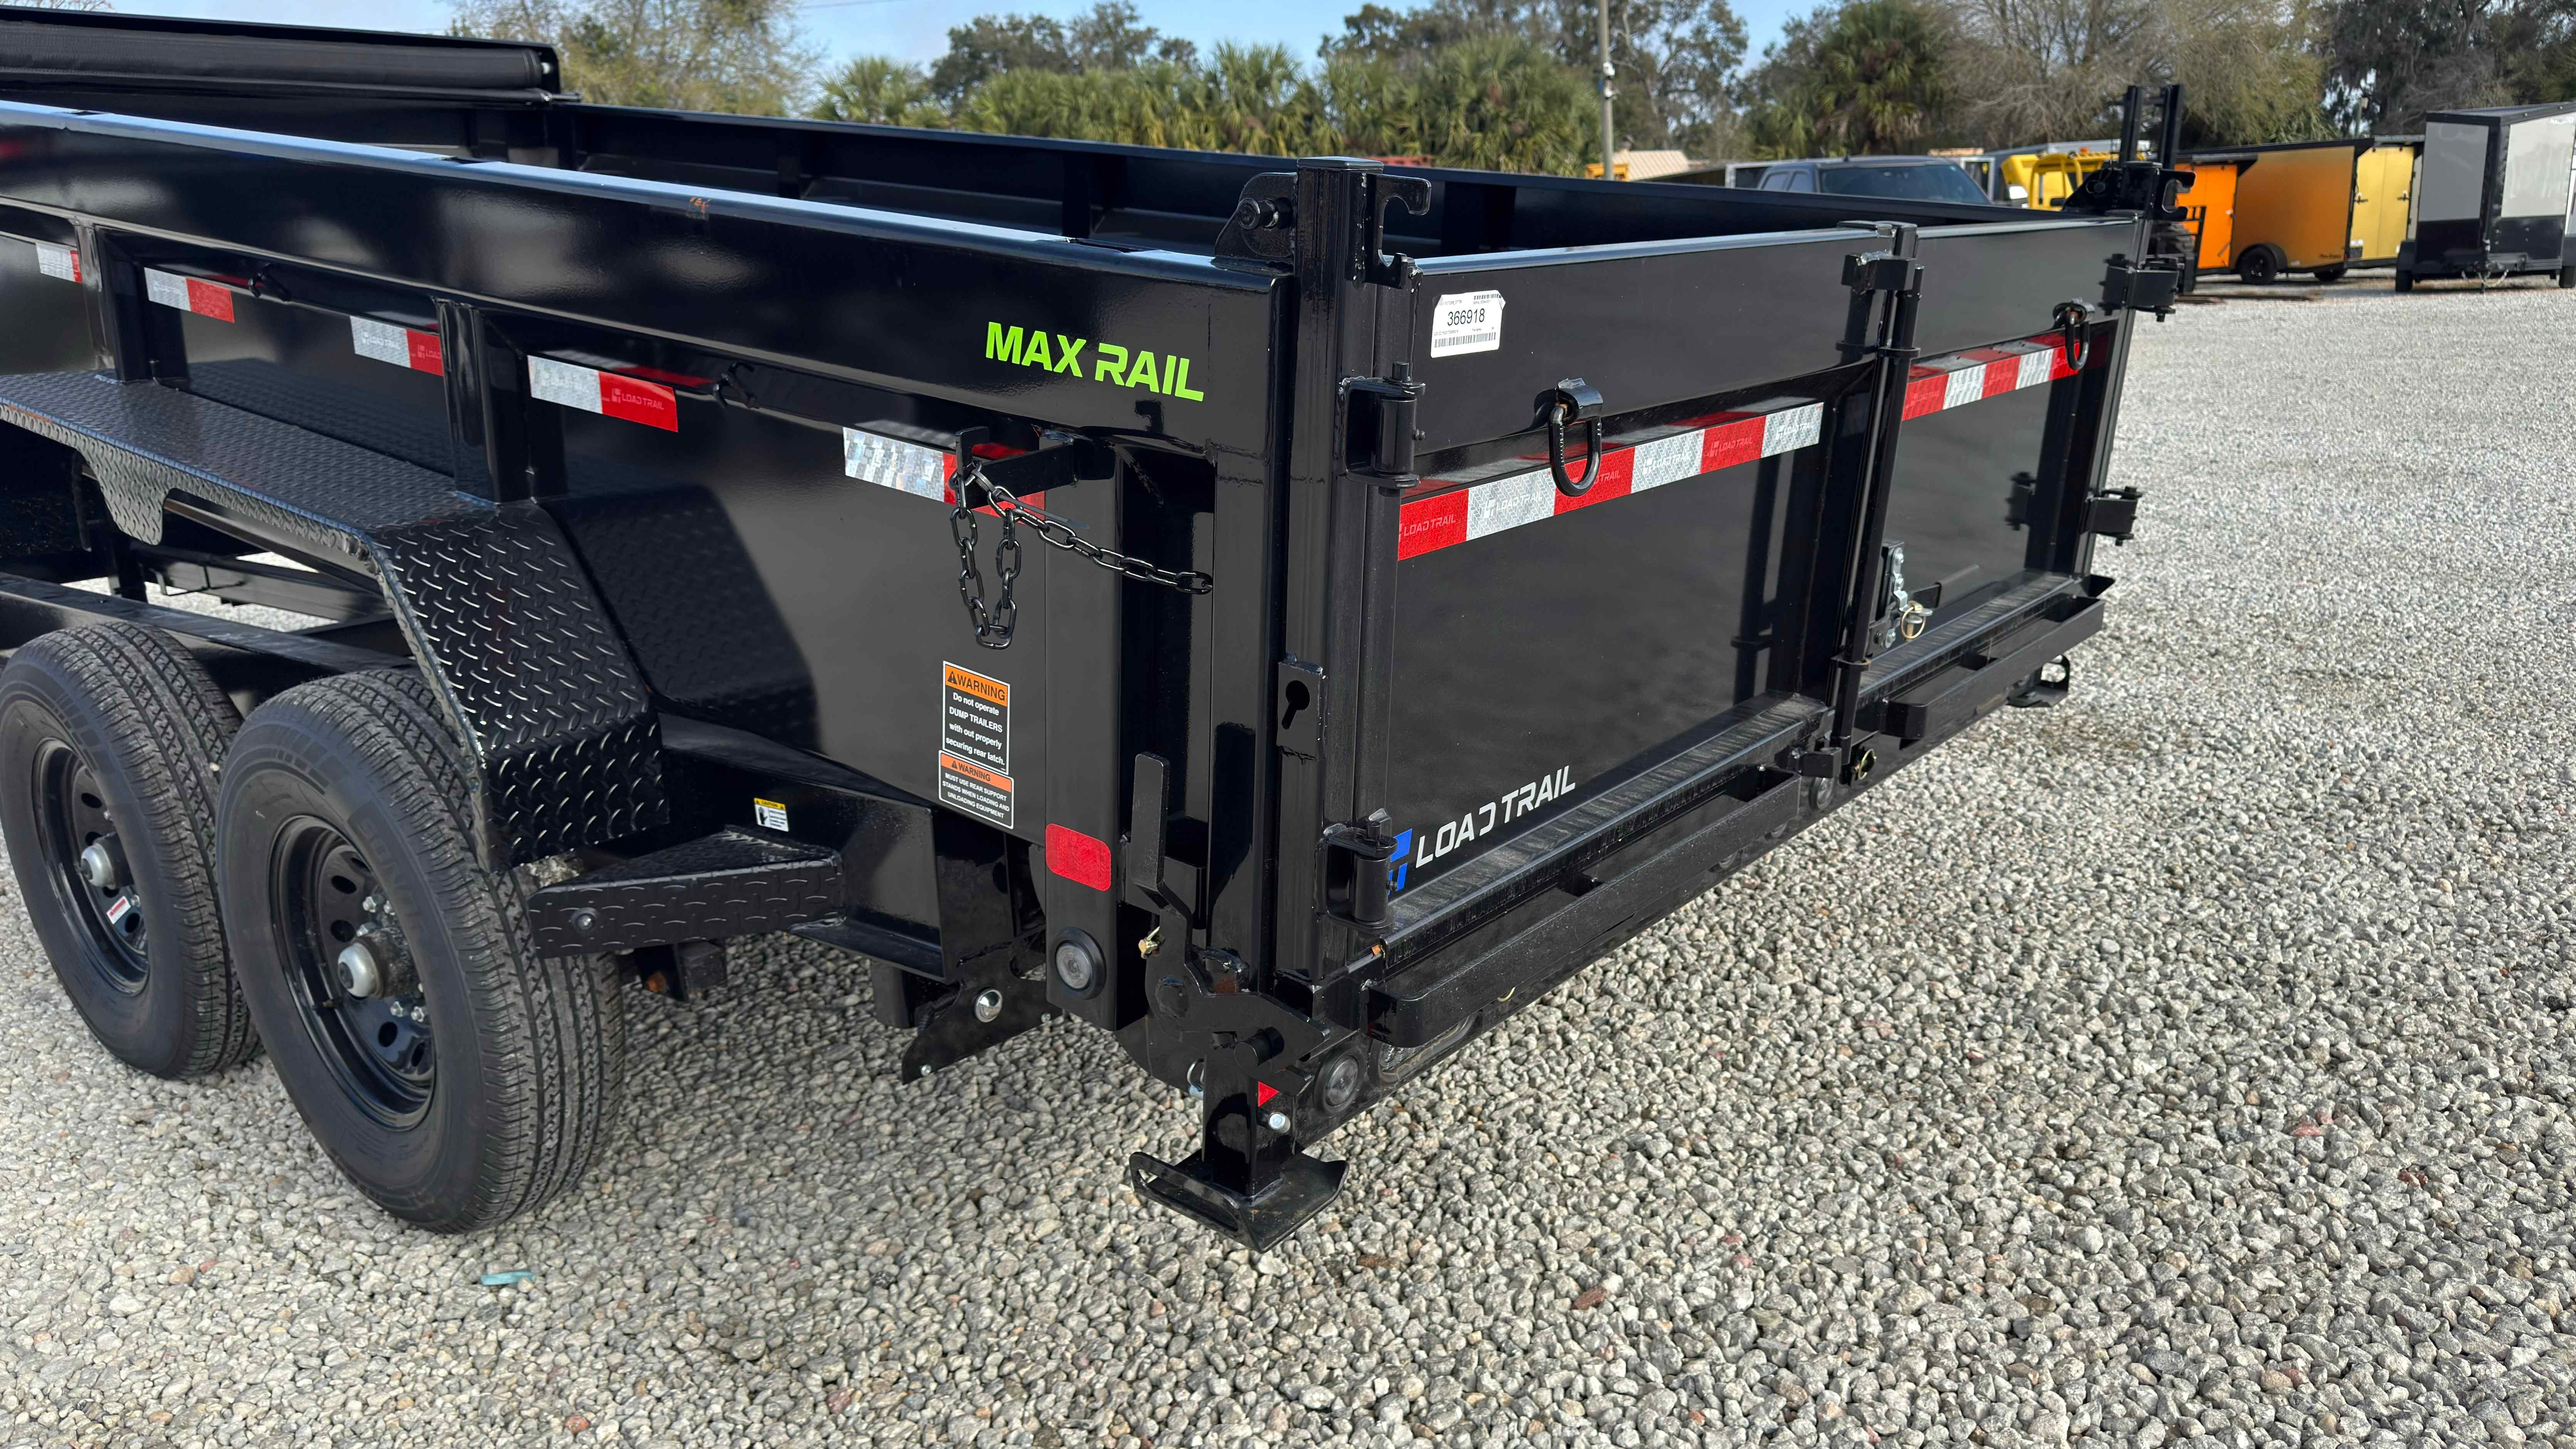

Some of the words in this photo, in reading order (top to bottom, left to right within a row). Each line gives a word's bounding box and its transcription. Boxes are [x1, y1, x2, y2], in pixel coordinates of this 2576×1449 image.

[1447, 308, 1485, 326] 366918
[986, 322, 1087, 377] MAX
[1095, 343, 1204, 402] RAIL
[958, 674, 1005, 701] WARNING
[953, 692, 962, 702] Do
[963, 697, 974, 706] not
[975, 702, 999, 716] operate
[949, 706, 969, 719] DUMP
[969, 714, 1003, 733] TRAILERS
[949, 723, 963, 733] with
[964, 729, 974, 738] out
[975, 733, 1002, 750] properly
[946, 738, 973, 754] securing
[974, 748, 986, 758] rear
[988, 752, 1005, 765] latch.
[958, 763, 991, 781] WARNING
[943, 781, 961, 792] STANDS
[962, 788, 976, 798] WHEN
[977, 794, 998, 807] LOADING
[999, 803, 1010, 812] AND
[945, 773, 958, 782] MUST
[959, 778, 969, 787] USE
[969, 783, 983, 792] REAR
[984, 788, 1007, 801] SUPPORT
[948, 792, 975, 807] UNLOADING
[976, 803, 1004, 818] EQUIPMENT
